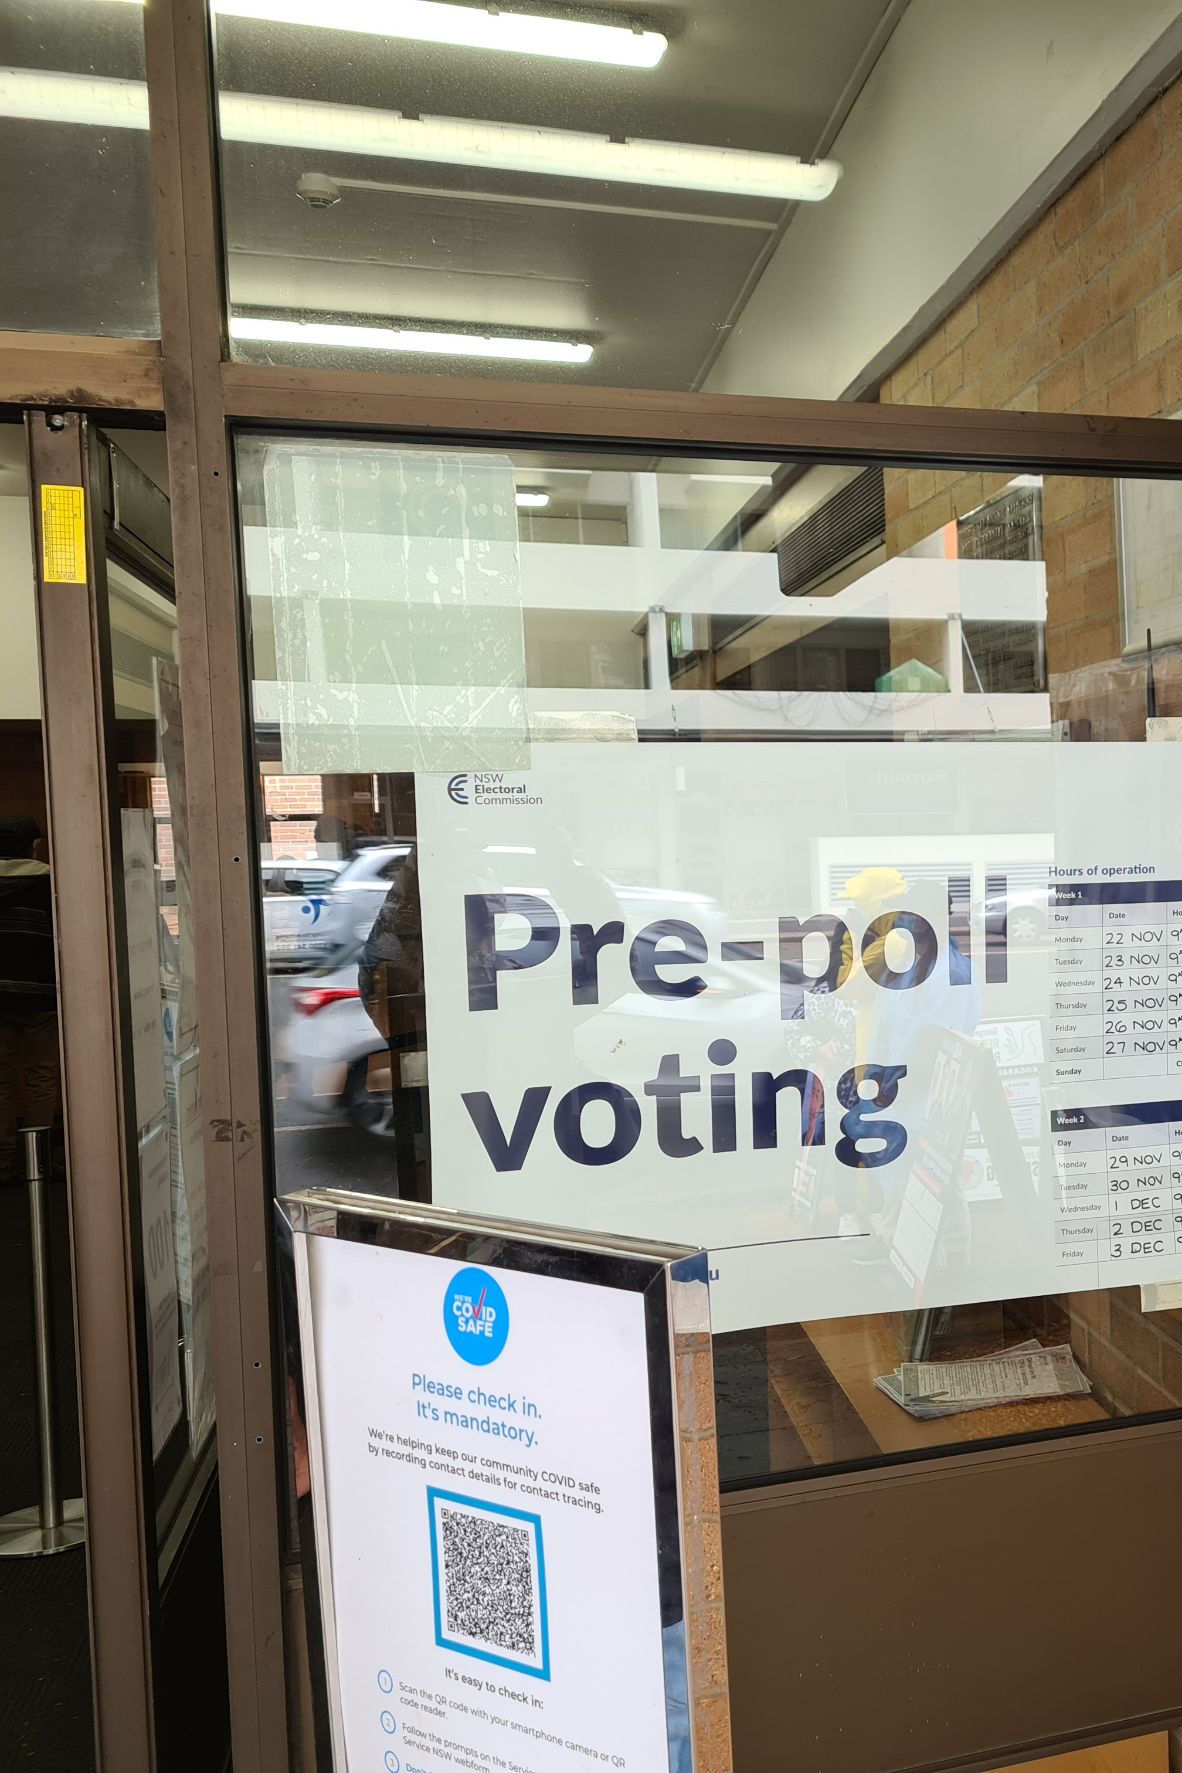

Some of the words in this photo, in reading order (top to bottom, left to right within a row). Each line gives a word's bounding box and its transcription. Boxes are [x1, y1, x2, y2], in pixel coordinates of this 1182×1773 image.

[474, 773, 504, 783] NSW
[474, 784, 526, 794] Electoral
[474, 795, 543, 805] Commission
[1048, 866, 1083, 877] Hours
[1086, 865, 1098, 876] of
[1101, 864, 1155, 877] operation
[1054, 914, 1069, 922] Day
[1054, 936, 1083, 944] Monday
[1105, 933, 1124, 945] 22
[1131, 930, 1163, 943] NOV
[464, 874, 1008, 1020] Pre-poll
[1054, 958, 1083, 966] Tuesday
[1104, 955, 1125, 968] 23
[1130, 954, 1160, 965] NOV
[1055, 979, 1096, 988] Wednesday
[1104, 977, 1124, 990] 24
[1129, 975, 1160, 986] NOV
[1055, 1002, 1087, 1010] Thursday
[1106, 1000, 1127, 1012] 25
[1134, 997, 1165, 1009] NOV
[1055, 1024, 1077, 1032] Friday
[1105, 1020, 1127, 1034] 26
[1133, 1019, 1164, 1031] NOV
[1055, 1046, 1087, 1054] Saturday
[1105, 1041, 1126, 1055] 27
[1134, 1040, 1166, 1053] NOV
[1055, 1067, 1082, 1076] Sunday
[461, 1038, 908, 1173] voting
[1056, 1117, 1078, 1125] Week
[1057, 1139, 1072, 1148] Day
[1058, 1161, 1087, 1169] Monday
[1109, 1156, 1128, 1169] 29
[1133, 1153, 1163, 1166] NOV
[1059, 1183, 1088, 1192] Tuesday
[1110, 1180, 1130, 1192] 30
[1137, 1175, 1164, 1188] NOV
[1060, 1204, 1102, 1213] Wednesday
[1114, 1201, 1118, 1211] 1
[1131, 1197, 1161, 1210] DEC
[1061, 1227, 1094, 1236] Thursday
[1112, 1223, 1123, 1236] 2
[1131, 1219, 1162, 1233] DEC
[1062, 1250, 1084, 1258] Friday
[1111, 1244, 1122, 1258] 3
[1130, 1241, 1164, 1254] DEC
[452, 1293, 496, 1322] COVID
[458, 1316, 493, 1338] SAFE
[411, 1373, 463, 1400] Please
[467, 1387, 518, 1414] check
[522, 1397, 542, 1419] in.
[417, 1400, 440, 1422] It's
[444, 1410, 539, 1448] mandatory.
[368, 1426, 395, 1443] We're
[397, 1434, 432, 1455] helping
[435, 1443, 459, 1461] keep
[461, 1453, 478, 1464] our
[480, 1457, 538, 1482] community
[541, 1471, 575, 1488] COVID
[578, 1482, 601, 1495] safe
[368, 1442, 379, 1457] by
[381, 1448, 426, 1469] recording
[429, 1460, 466, 1477] contact
[468, 1469, 501, 1487] details
[504, 1477, 517, 1490] for
[520, 1483, 560, 1502] contact
[562, 1493, 604, 1514] tracing.
[445, 1667, 459, 1681] It's
[461, 1675, 483, 1691] easy
[486, 1681, 496, 1693] to
[498, 1686, 529, 1705] check
[531, 1695, 544, 1710] in:
[400, 1696, 419, 1709] code
[421, 1704, 448, 1720] reader.
[399, 1682, 418, 1694] Scan
[419, 1690, 433, 1701] the
[435, 1694, 447, 1706] QR
[448, 1702, 468, 1713] code
[470, 1708, 489, 1720] with
[490, 1714, 509, 1727] your
[510, 1720, 563, 1746] smartphone
[565, 1740, 598, 1759] camera
[600, 1752, 609, 1761] or
[611, 1755, 626, 1768] QR
[402, 1723, 427, 1739] Follow
[429, 1733, 442, 1745] the
[444, 1740, 479, 1758] prompts
[480, 1752, 491, 1763] on
[492, 1756, 506, 1769] the
[403, 1736, 431, 1753] Service
[433, 1747, 452, 1761] NSW
